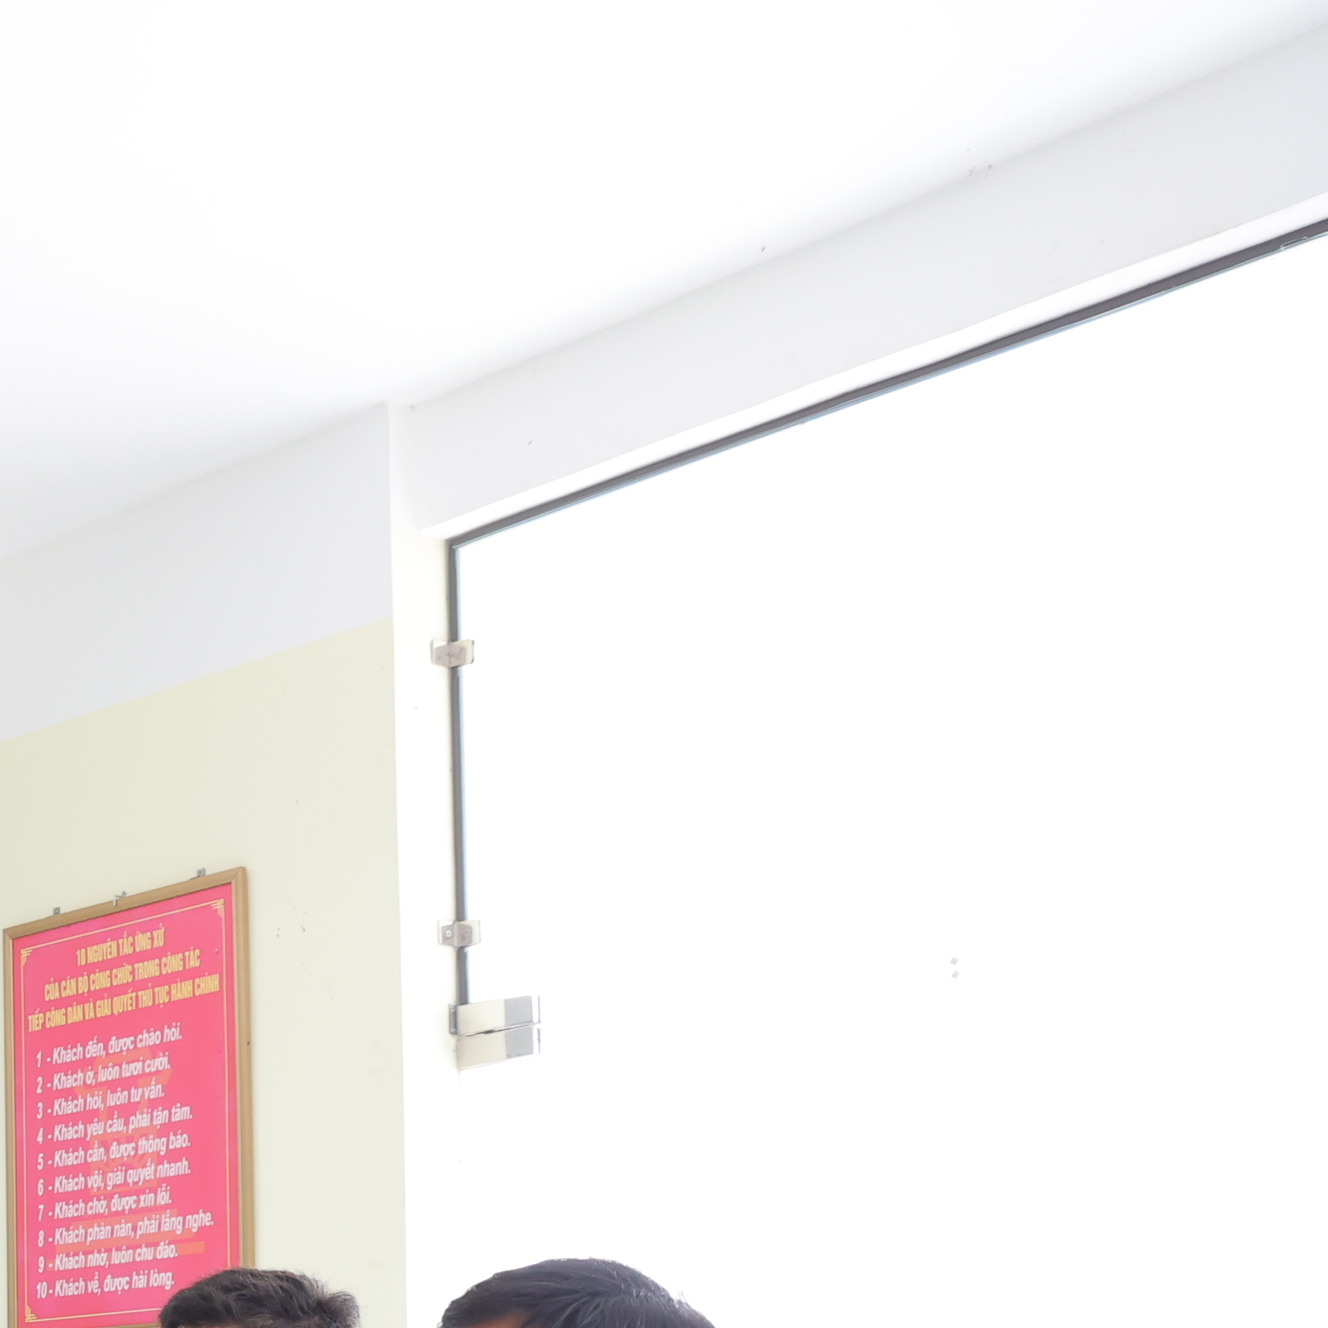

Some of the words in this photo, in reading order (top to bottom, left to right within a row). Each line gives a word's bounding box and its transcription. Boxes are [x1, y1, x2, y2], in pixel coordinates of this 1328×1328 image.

[76, 948, 86, 966] 10
[87, 938, 117, 964] NGUYÊN
[118, 931, 134, 956] TẮC
[135, 931, 152, 952] ỨNG
[152, 923, 165, 948] XỬ
[45, 977, 60, 1001] CỦA
[61, 976, 77, 998] CÁN
[78, 972, 88, 996] BỘ
[90, 969, 111, 991] CÔNG
[112, 962, 132, 986] CHỨC
[134, 958, 160, 980] TRONG
[162, 952, 183, 975] CÔNG
[184, 946, 200, 970] TÁC
[28, 1008, 44, 1032] TIẾP
[45, 1007, 66, 1029] CÔNG
[67, 1002, 83, 1024] DÂN
[84, 998, 95, 1020] VÀ
[96, 993, 111, 1018] GIẢI
[113, 987, 136, 1016] QUYẾT
[138, 983, 153, 1008] THỦ
[154, 985, 169, 1008] TỤC
[171, 979, 193, 1001] HÀNH
[194, 972, 220, 996] CHÍNH
[36, 1051, 42, 1068] 1
[53, 1043, 83, 1065] Khách
[85, 1036, 105, 1059] đến,
[109, 1036, 134, 1055] được
[137, 1028, 161, 1048] chào
[163, 1022, 182, 1044] hỏi.
[37, 1077, 42, 1094] 2
[53, 1069, 83, 1090] Khách
[86, 1067, 95, 1086] ở,
[98, 1063, 120, 1082] luôn
[122, 1057, 142, 1077] tươi
[145, 1052, 171, 1073] cười.
[37, 1102, 43, 1119] 3
[54, 1095, 83, 1116] Khách
[86, 1091, 104, 1111] hỏi,
[107, 1087, 128, 1107] luôn
[131, 1086, 142, 1103] tư
[144, 1078, 165, 1099] vấn.
[37, 1128, 43, 1144] 4
[54, 1121, 84, 1142] Khách
[86, 1118, 104, 1141] yêu
[106, 1111, 126, 1134] cầu,
[129, 1108, 151, 1134] phải
[153, 1107, 169, 1128] tận
[171, 1103, 192, 1121] tâm.
[37, 1154, 43, 1170] 5
[54, 1146, 84, 1168] Khách
[87, 1141, 106, 1163] cần,
[110, 1141, 135, 1160] được
[138, 1135, 167, 1155] thông
[169, 1130, 190, 1149] báo.
[37, 1179, 43, 1196] 6
[54, 1172, 84, 1193] Khách
[87, 1170, 104, 1191] vội,
[107, 1166, 125, 1190] giải
[127, 1159, 154, 1187] quyết
[157, 1157, 191, 1179] nhanh.
[38, 1205, 44, 1221] 7
[54, 1198, 84, 1219] Khách
[87, 1196, 108, 1215] chờ,
[111, 1194, 137, 1214] được
[139, 1190, 154, 1207] xin
[156, 1183, 172, 1204] lỗi.
[38, 1230, 44, 1247] 8
[54, 1224, 84, 1245] Khách
[87, 1221, 110, 1245] phàn
[114, 1219, 134, 1238] nàn,
[136, 1215, 159, 1239] phải
[161, 1209, 182, 1234] lắng
[185, 1209, 214, 1232] nghe.
[38, 1256, 44, 1273] 9
[55, 1251, 84, 1271] Khách
[87, 1249, 109, 1268] nhờ,
[111, 1246, 133, 1264] luôn
[135, 1244, 154, 1262] chu
[156, 1241, 178, 1259] đáo.
[36, 1282, 47, 1299] 10
[55, 1277, 84, 1297] Khách
[87, 1272, 101, 1295] về,
[104, 1275, 129, 1294] được
[132, 1271, 147, 1289] hài
[150, 1269, 174, 1290] lòng.
